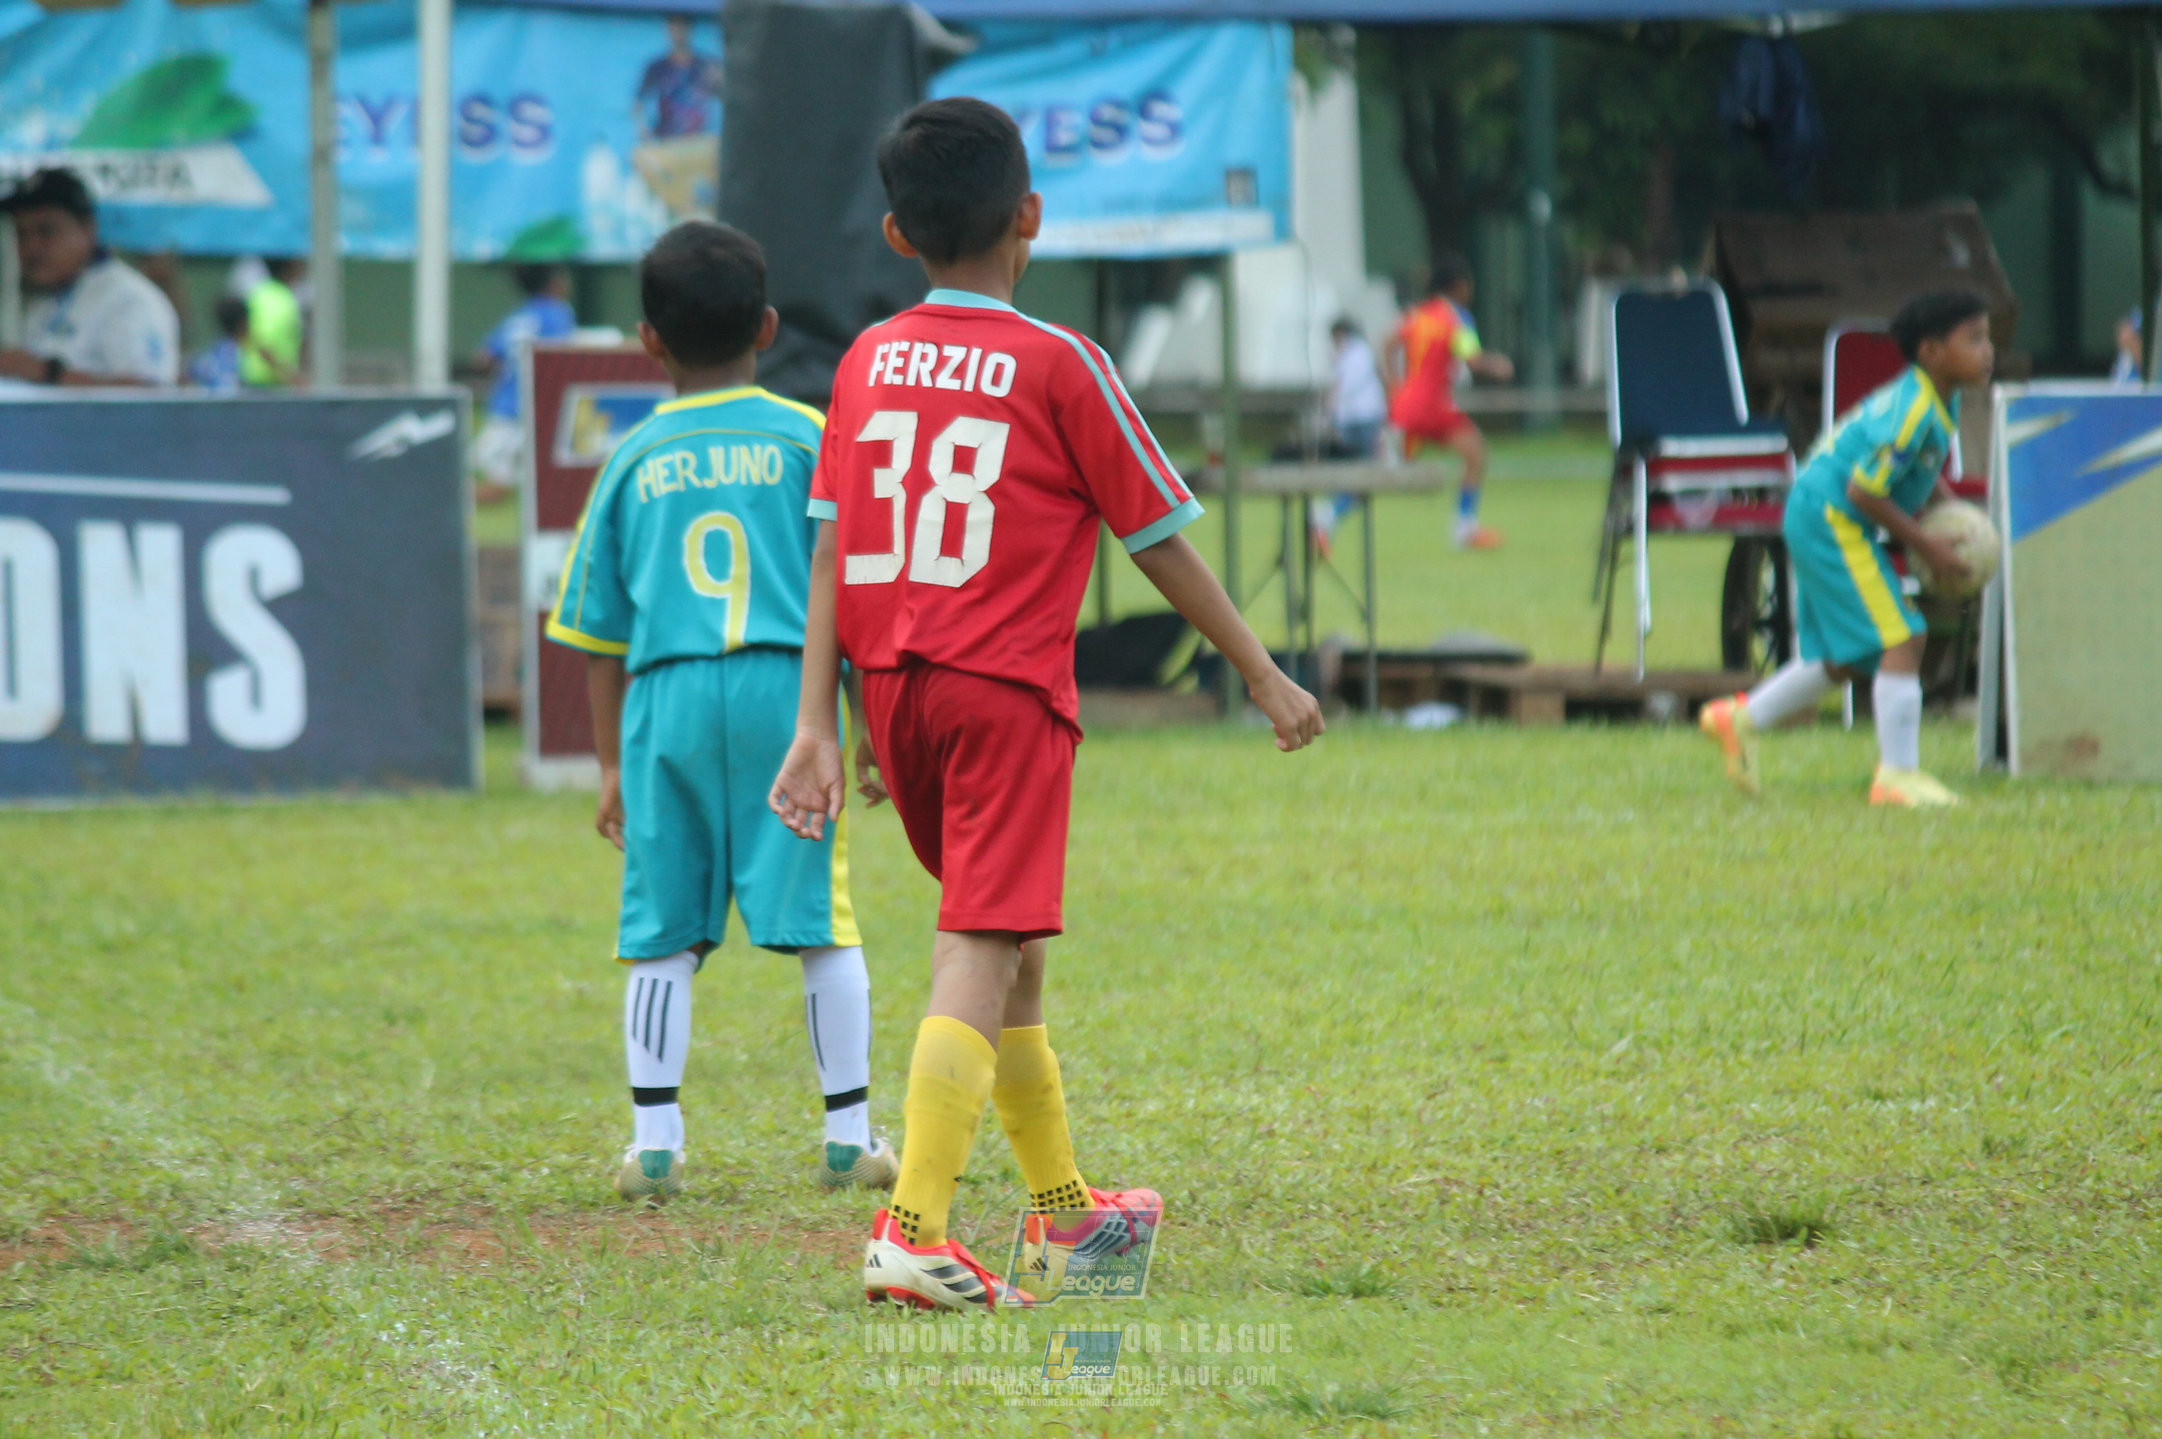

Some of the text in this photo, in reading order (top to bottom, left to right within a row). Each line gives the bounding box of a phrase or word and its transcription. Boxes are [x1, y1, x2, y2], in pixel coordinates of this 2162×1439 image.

[868, 341, 1017, 398] FERZIO
[636, 444, 784, 503] HERJUNO
[844, 410, 1011, 588] 38
[682, 511, 752, 654] 9
